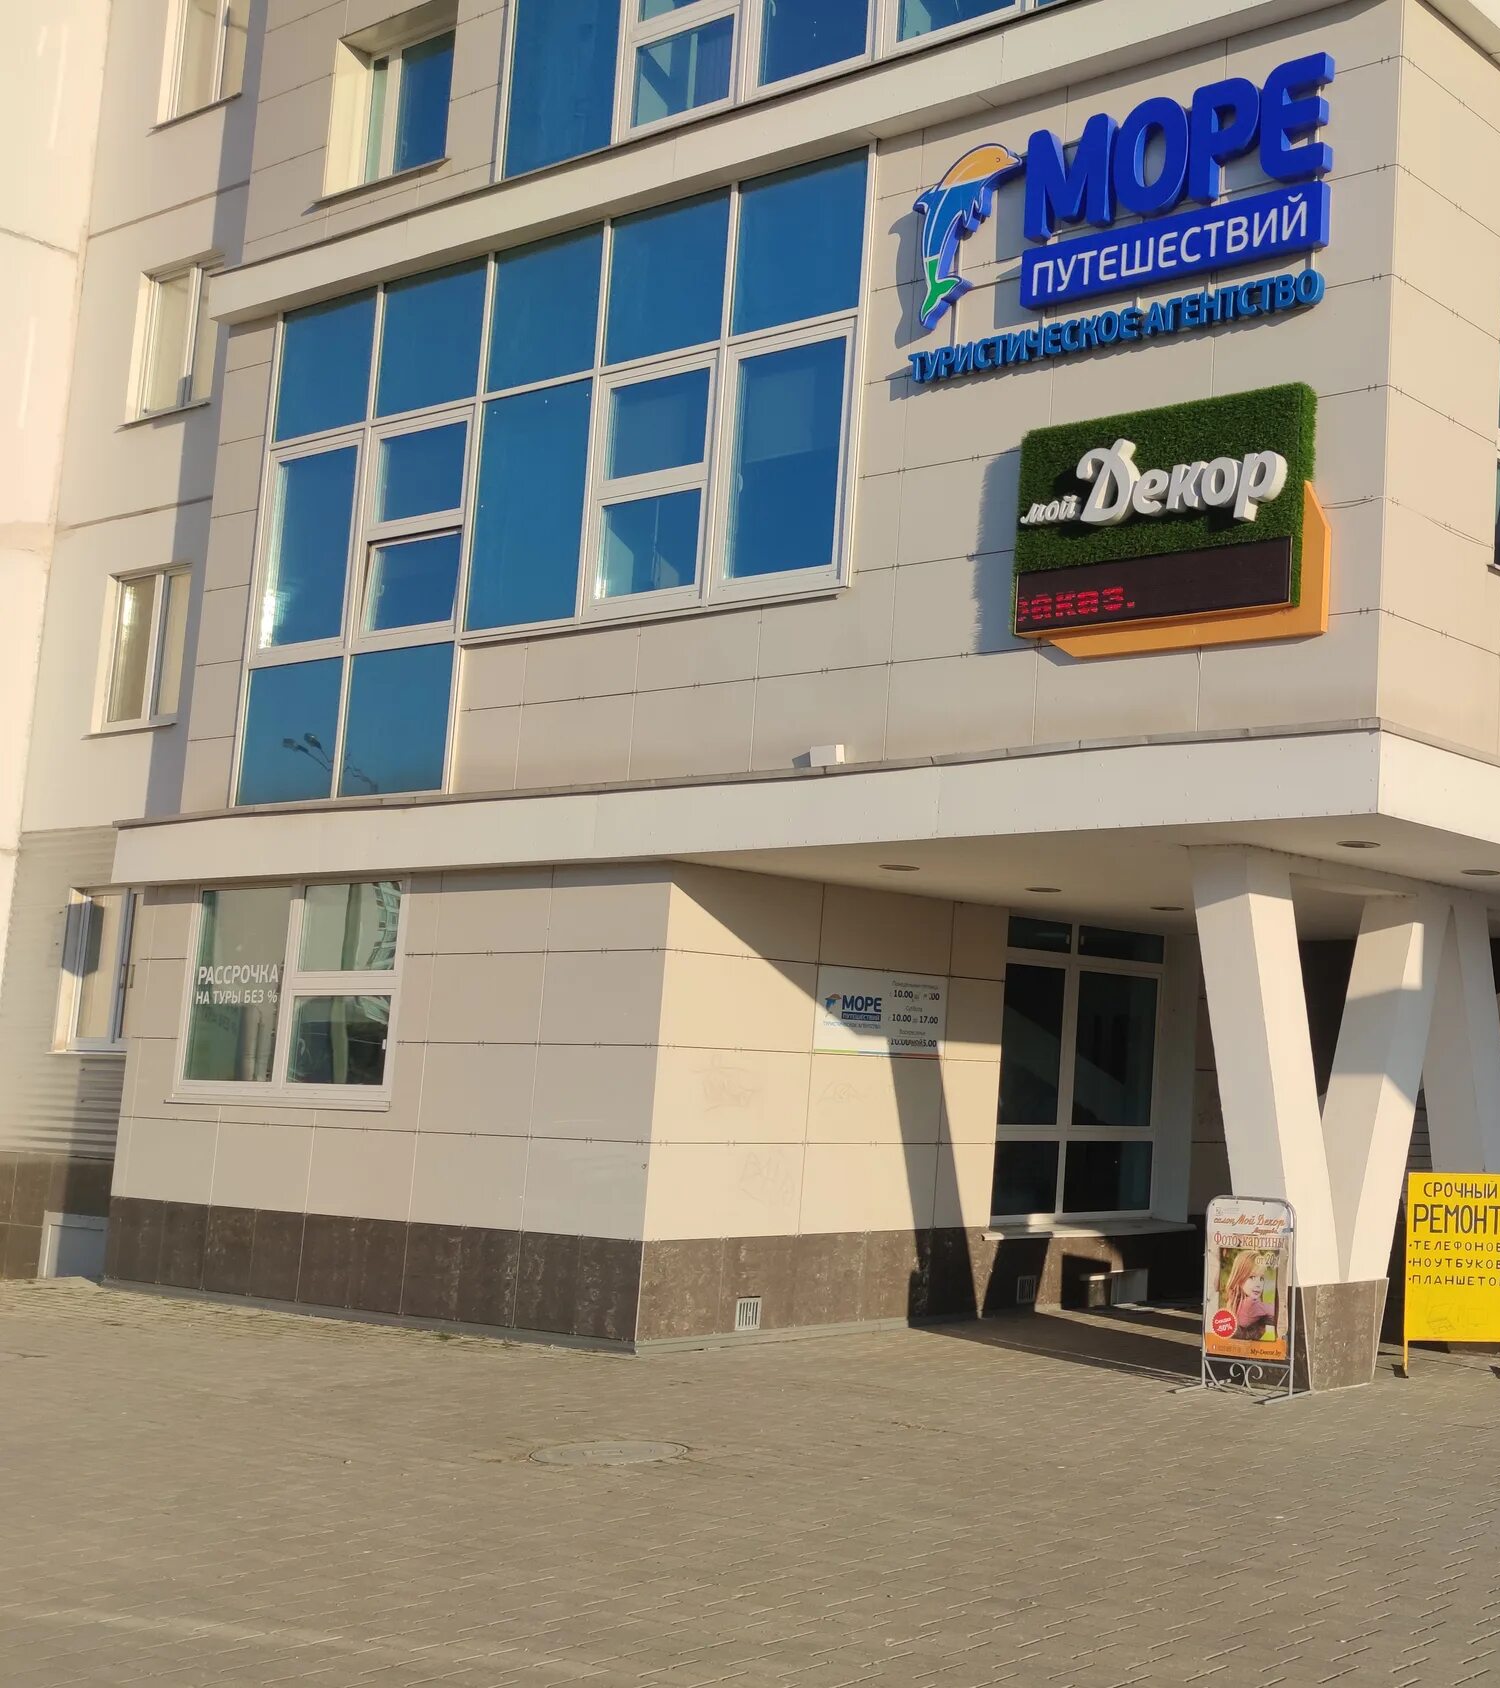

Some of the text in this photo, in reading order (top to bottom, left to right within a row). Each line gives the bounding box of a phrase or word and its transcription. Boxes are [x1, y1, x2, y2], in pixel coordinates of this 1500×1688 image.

[1024, 51, 1335, 243] МОРЕ
[1031, 192, 1309, 297] ПУТЕШЕСТВИЙ
[908, 268, 1326, 384] ТУРИСТИЧЕСКОЕ АГЕНТСТВО
[1076, 438, 1288, 526] Декор
[198, 964, 279, 985] РАССРОЧКА
[195, 991, 210, 1004] НА
[213, 990, 242, 1004] ТУРЫ
[243, 989, 265, 1004] БЕЗ
[842, 994, 882, 1012] МОРЕ
[893, 989, 914, 999] 10.00
[891, 1013, 939, 1025] 10.00 17.00
[1423, 1181, 1498, 1199] СРОЧНЫЙ
